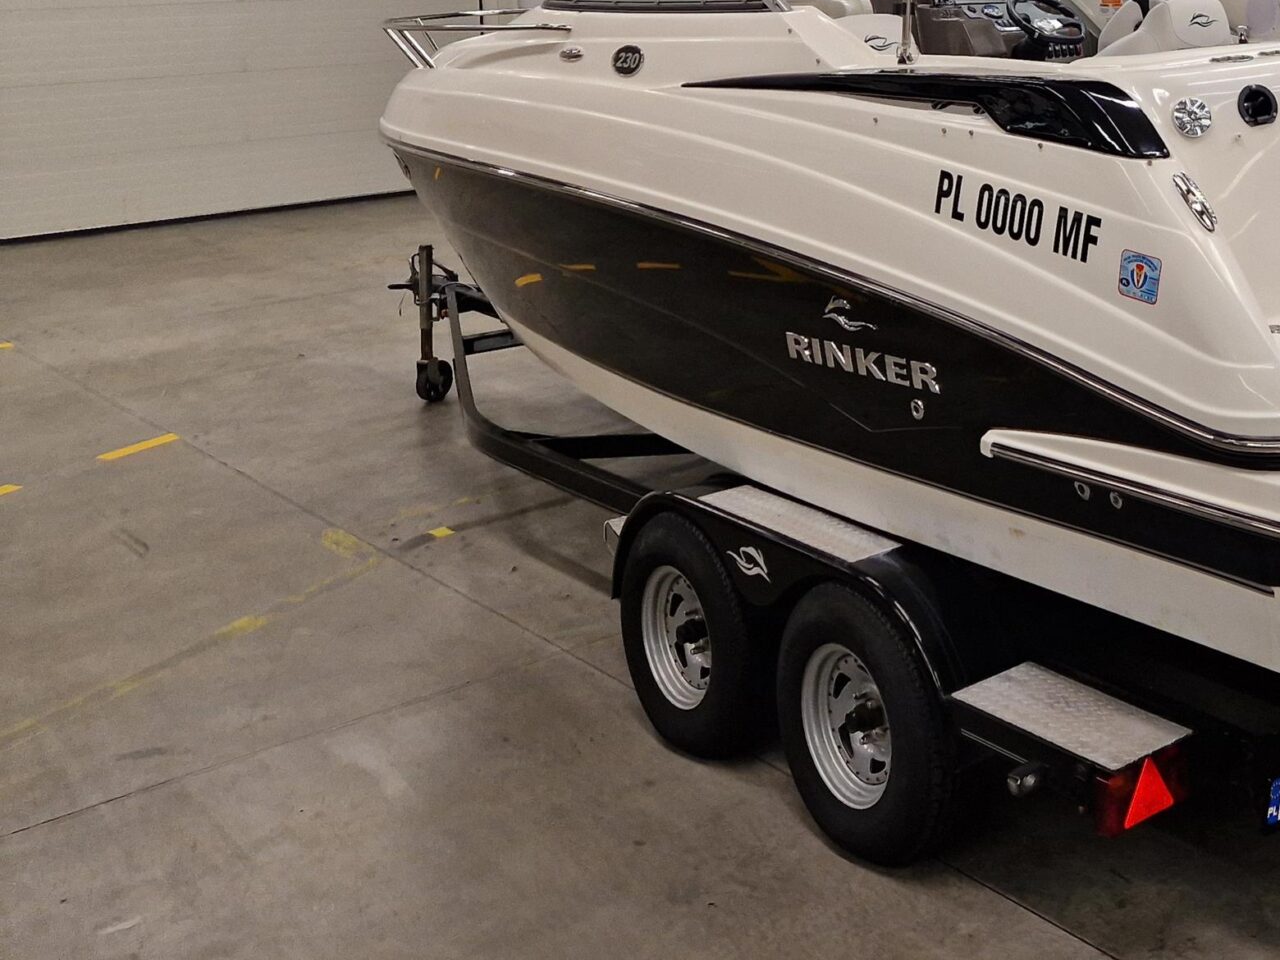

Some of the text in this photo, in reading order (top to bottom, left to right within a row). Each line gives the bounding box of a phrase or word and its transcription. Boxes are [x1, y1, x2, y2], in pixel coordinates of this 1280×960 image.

[615, 52, 640, 68] 230
[935, 169, 1102, 263] PL 0000 MF
[785, 331, 941, 395] RINKER
[1266, 806, 1278, 819] PL
